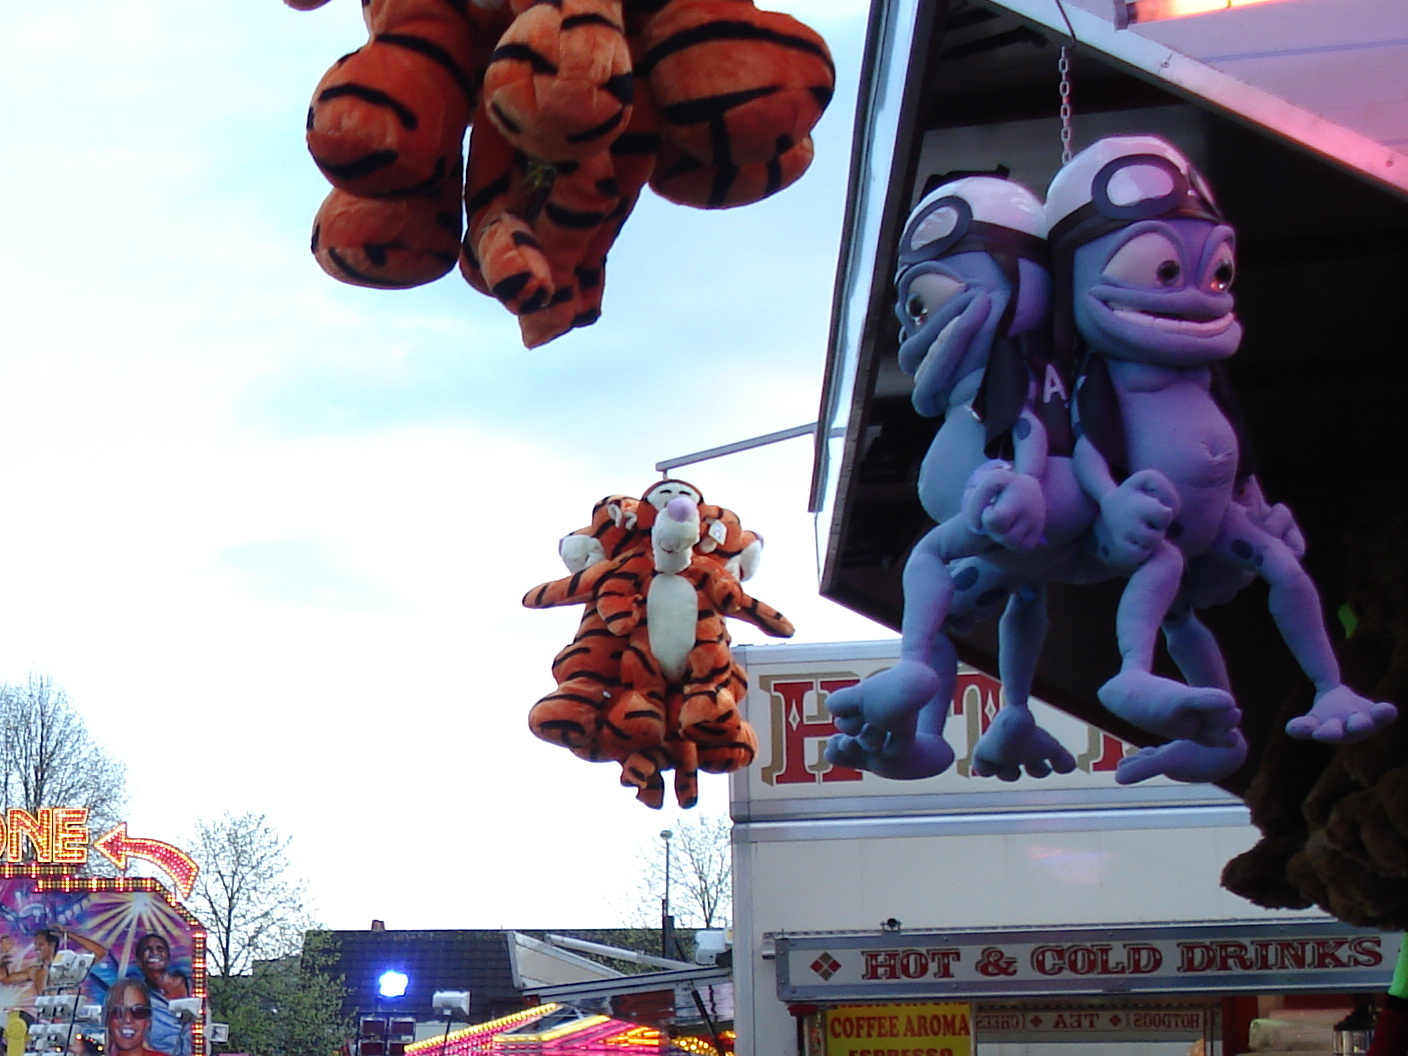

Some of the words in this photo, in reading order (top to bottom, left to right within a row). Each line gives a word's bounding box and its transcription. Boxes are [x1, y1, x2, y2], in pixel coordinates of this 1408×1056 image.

[861, 947, 961, 981] HOT
[975, 945, 1018, 978] &
[1030, 942, 1164, 978] COLD
[1177, 936, 1383, 974] DRINKS
[830, 1016, 899, 1038] COFFEE
[903, 1013, 970, 1037] AROMA
